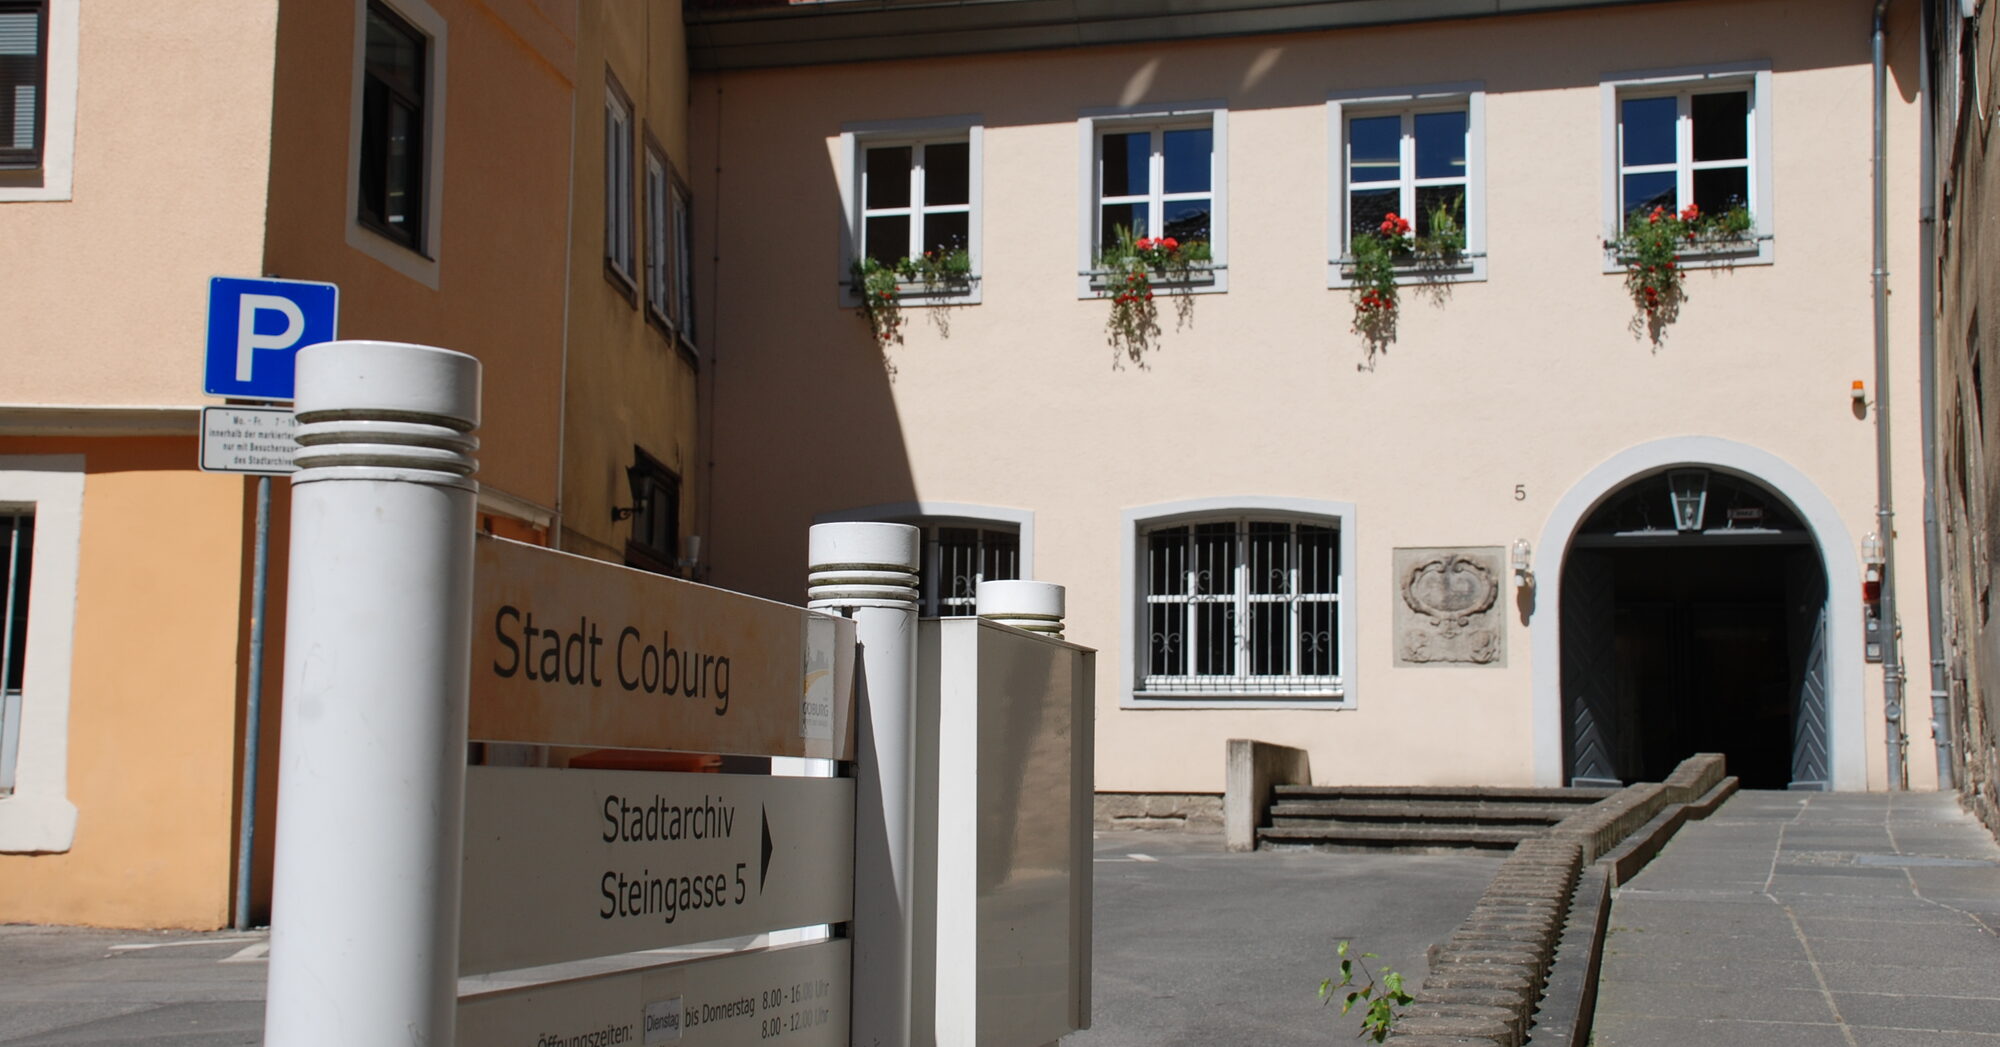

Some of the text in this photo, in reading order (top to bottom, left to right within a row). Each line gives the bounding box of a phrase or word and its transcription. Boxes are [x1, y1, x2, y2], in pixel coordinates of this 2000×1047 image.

[235, 293, 305, 382] P
[208, 428, 242, 438] innerhalb
[244, 429, 256, 438] der
[223, 443, 235, 451] nur
[236, 443, 248, 451] mit
[234, 455, 246, 465] des
[1514, 484, 1526, 501] 5
[493, 605, 730, 717] Stadt Coburg
[602, 794, 735, 843] Stadtarchiv
[600, 863, 746, 924] Steingasse 5
[646, 1012, 680, 1032] Dienstag
[685, 1007, 699, 1028] bis
[702, 997, 755, 1024] Donnerstag
[762, 988, 781, 1010] 8.00
[815, 979, 830, 998] Uhr
[761, 1017, 781, 1039] 8.00
[814, 1008, 829, 1026] Uhr
